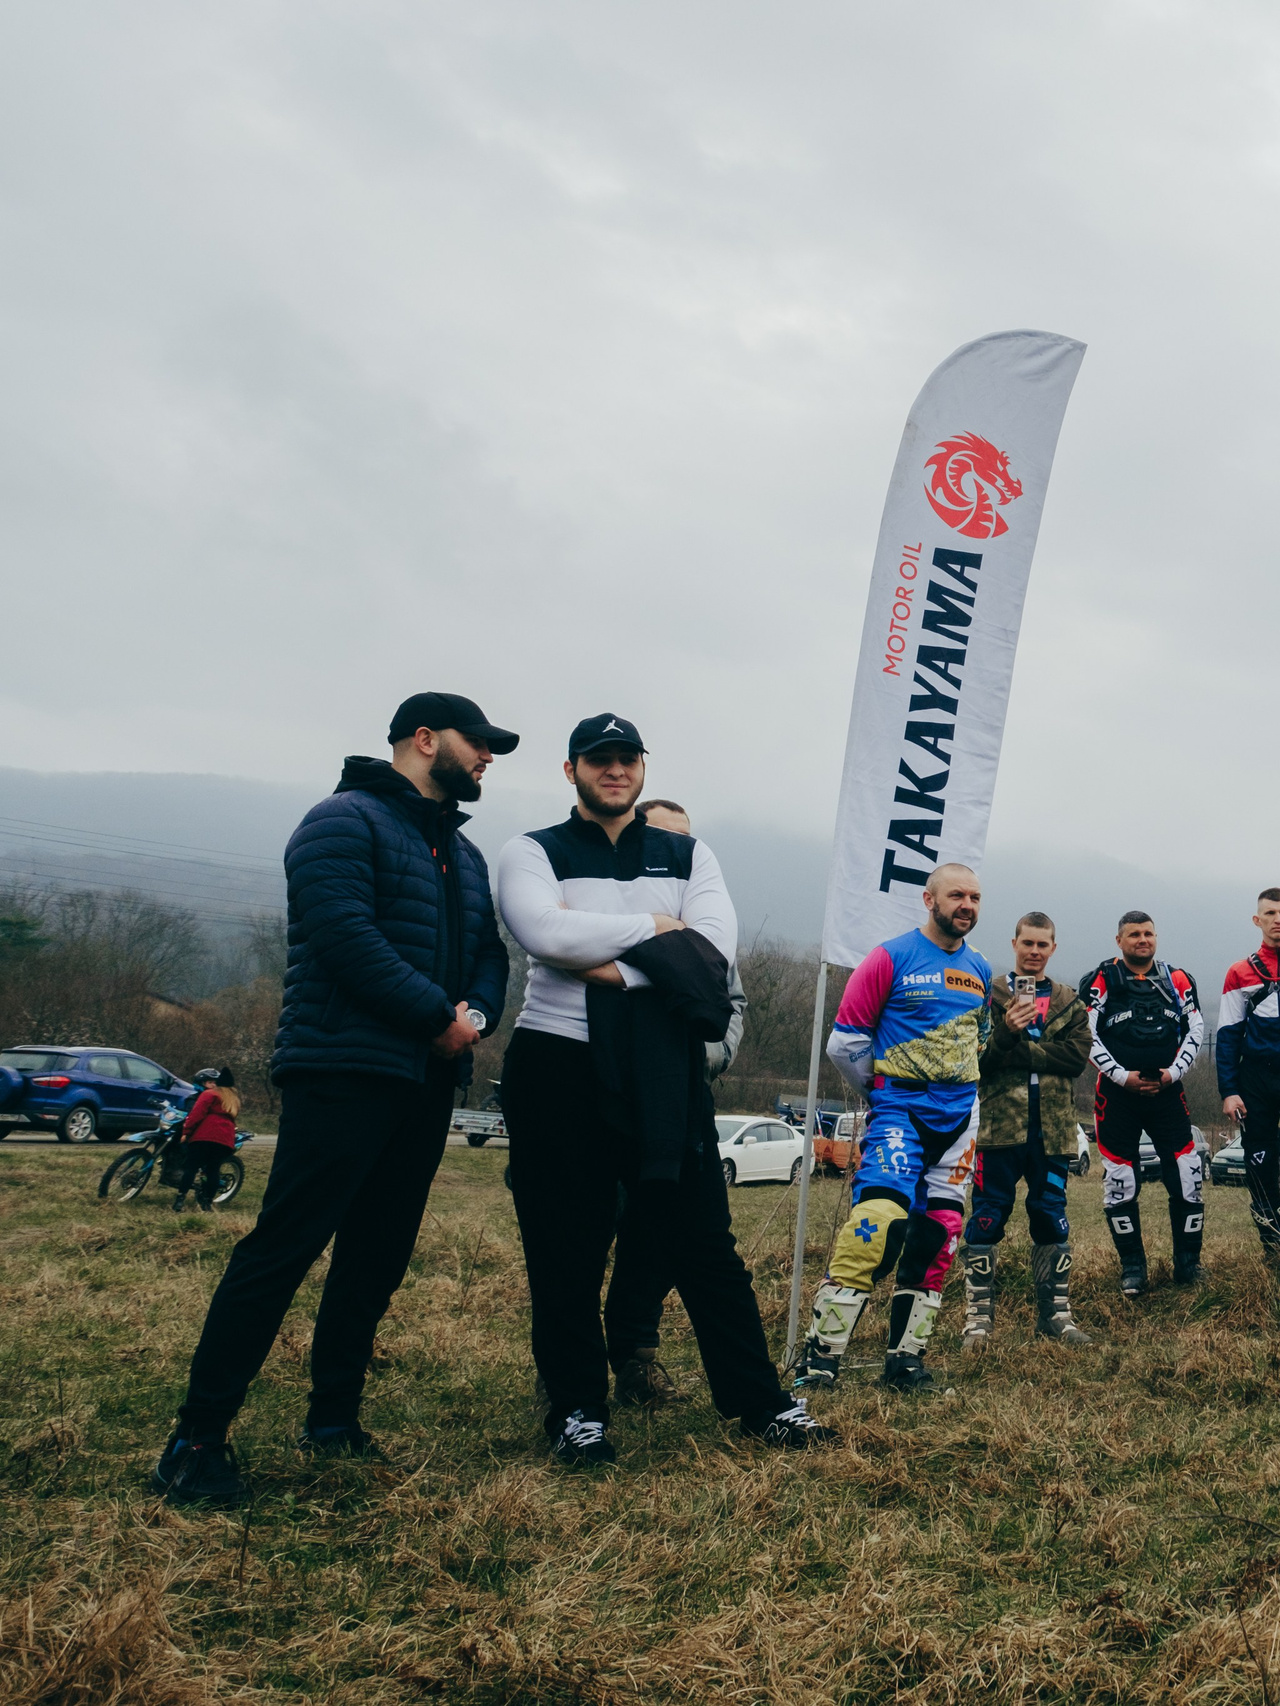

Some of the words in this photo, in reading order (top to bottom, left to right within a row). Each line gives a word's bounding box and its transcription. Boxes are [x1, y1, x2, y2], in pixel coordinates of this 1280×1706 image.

[882, 586, 915, 678] MOTOR
[899, 540, 923, 581] OIL
[879, 546, 984, 893] TAKAYAMA
[902, 972, 942, 985] Hard
